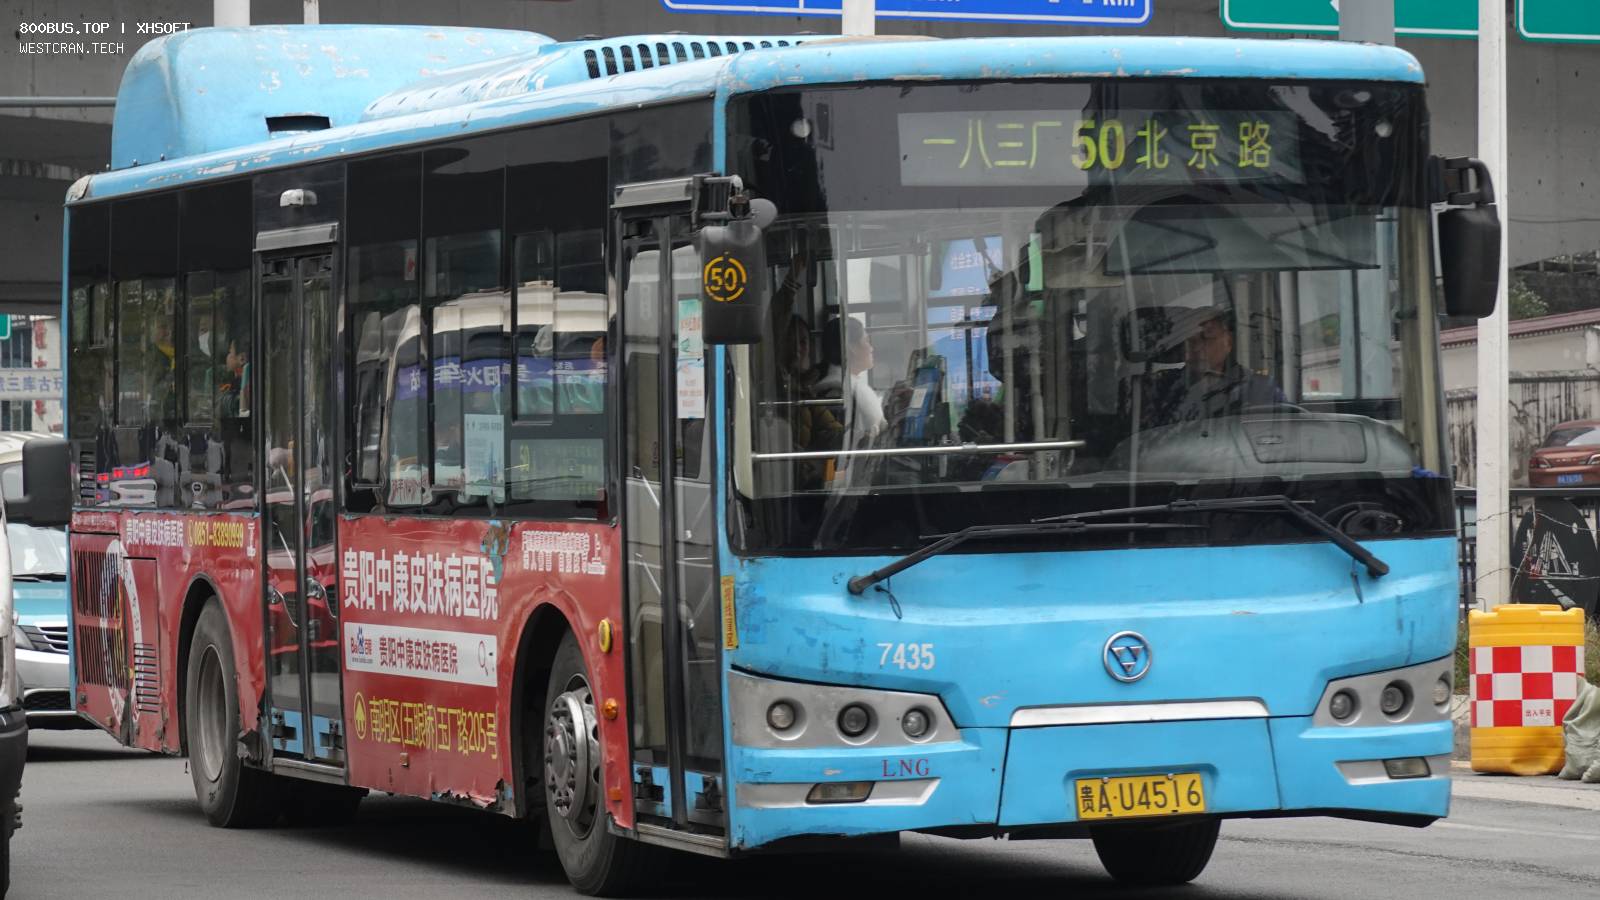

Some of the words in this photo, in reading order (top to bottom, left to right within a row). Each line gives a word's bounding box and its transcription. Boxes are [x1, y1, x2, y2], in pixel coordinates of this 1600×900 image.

[922, 119, 1063, 169] 一八三厂
[1071, 119, 1126, 170] 50
[1136, 119, 1272, 169] 北京路
[711, 267, 738, 291] 50
[343, 547, 499, 621] 贵阳中康皮肤病医院
[379, 635, 459, 675] 贵阳中康皮肤病医院
[876, 642, 936, 671] 7435
[881, 758, 931, 777] LNG
